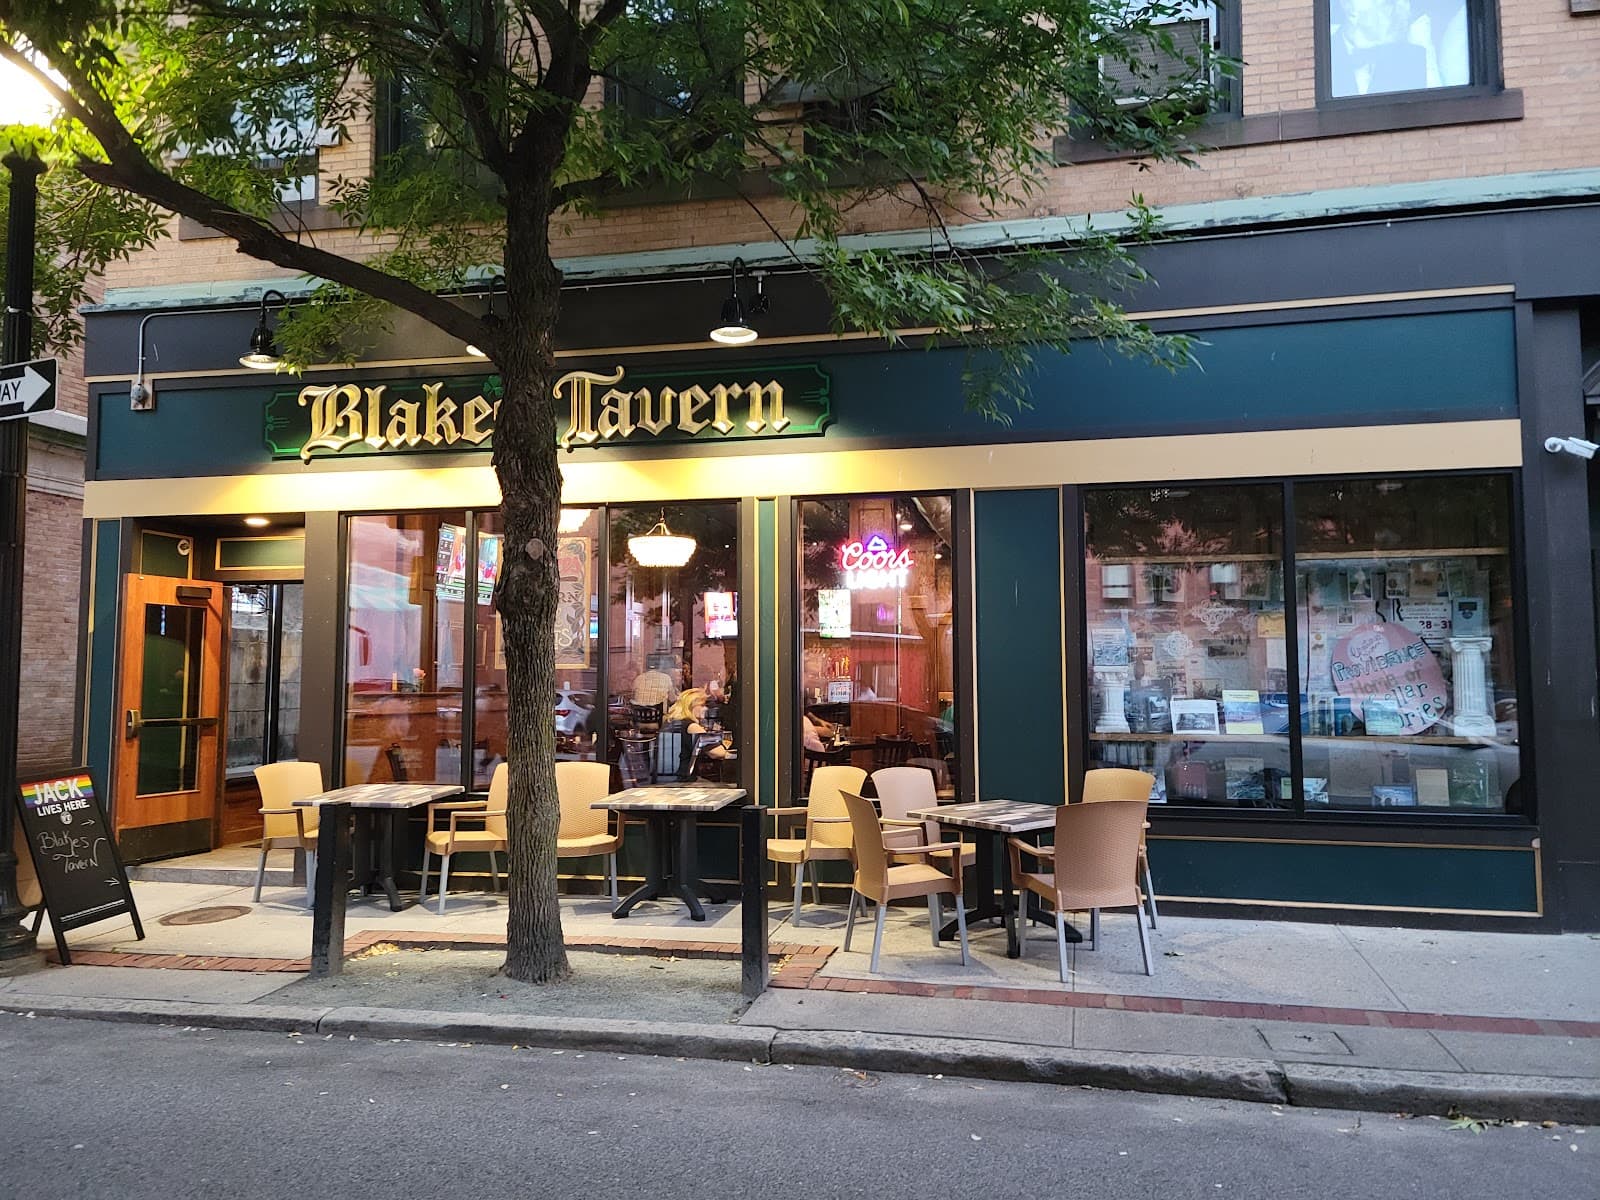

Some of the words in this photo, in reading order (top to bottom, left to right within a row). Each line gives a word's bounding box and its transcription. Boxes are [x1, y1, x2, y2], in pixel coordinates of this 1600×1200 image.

[0, 380, 21, 402] AY
[298, 382, 501, 463] Blake
[553, 366, 791, 450] Tavern
[841, 542, 914, 570] Coors
[34, 778, 84, 805] JACK
[37, 803, 63, 817] LIVES
